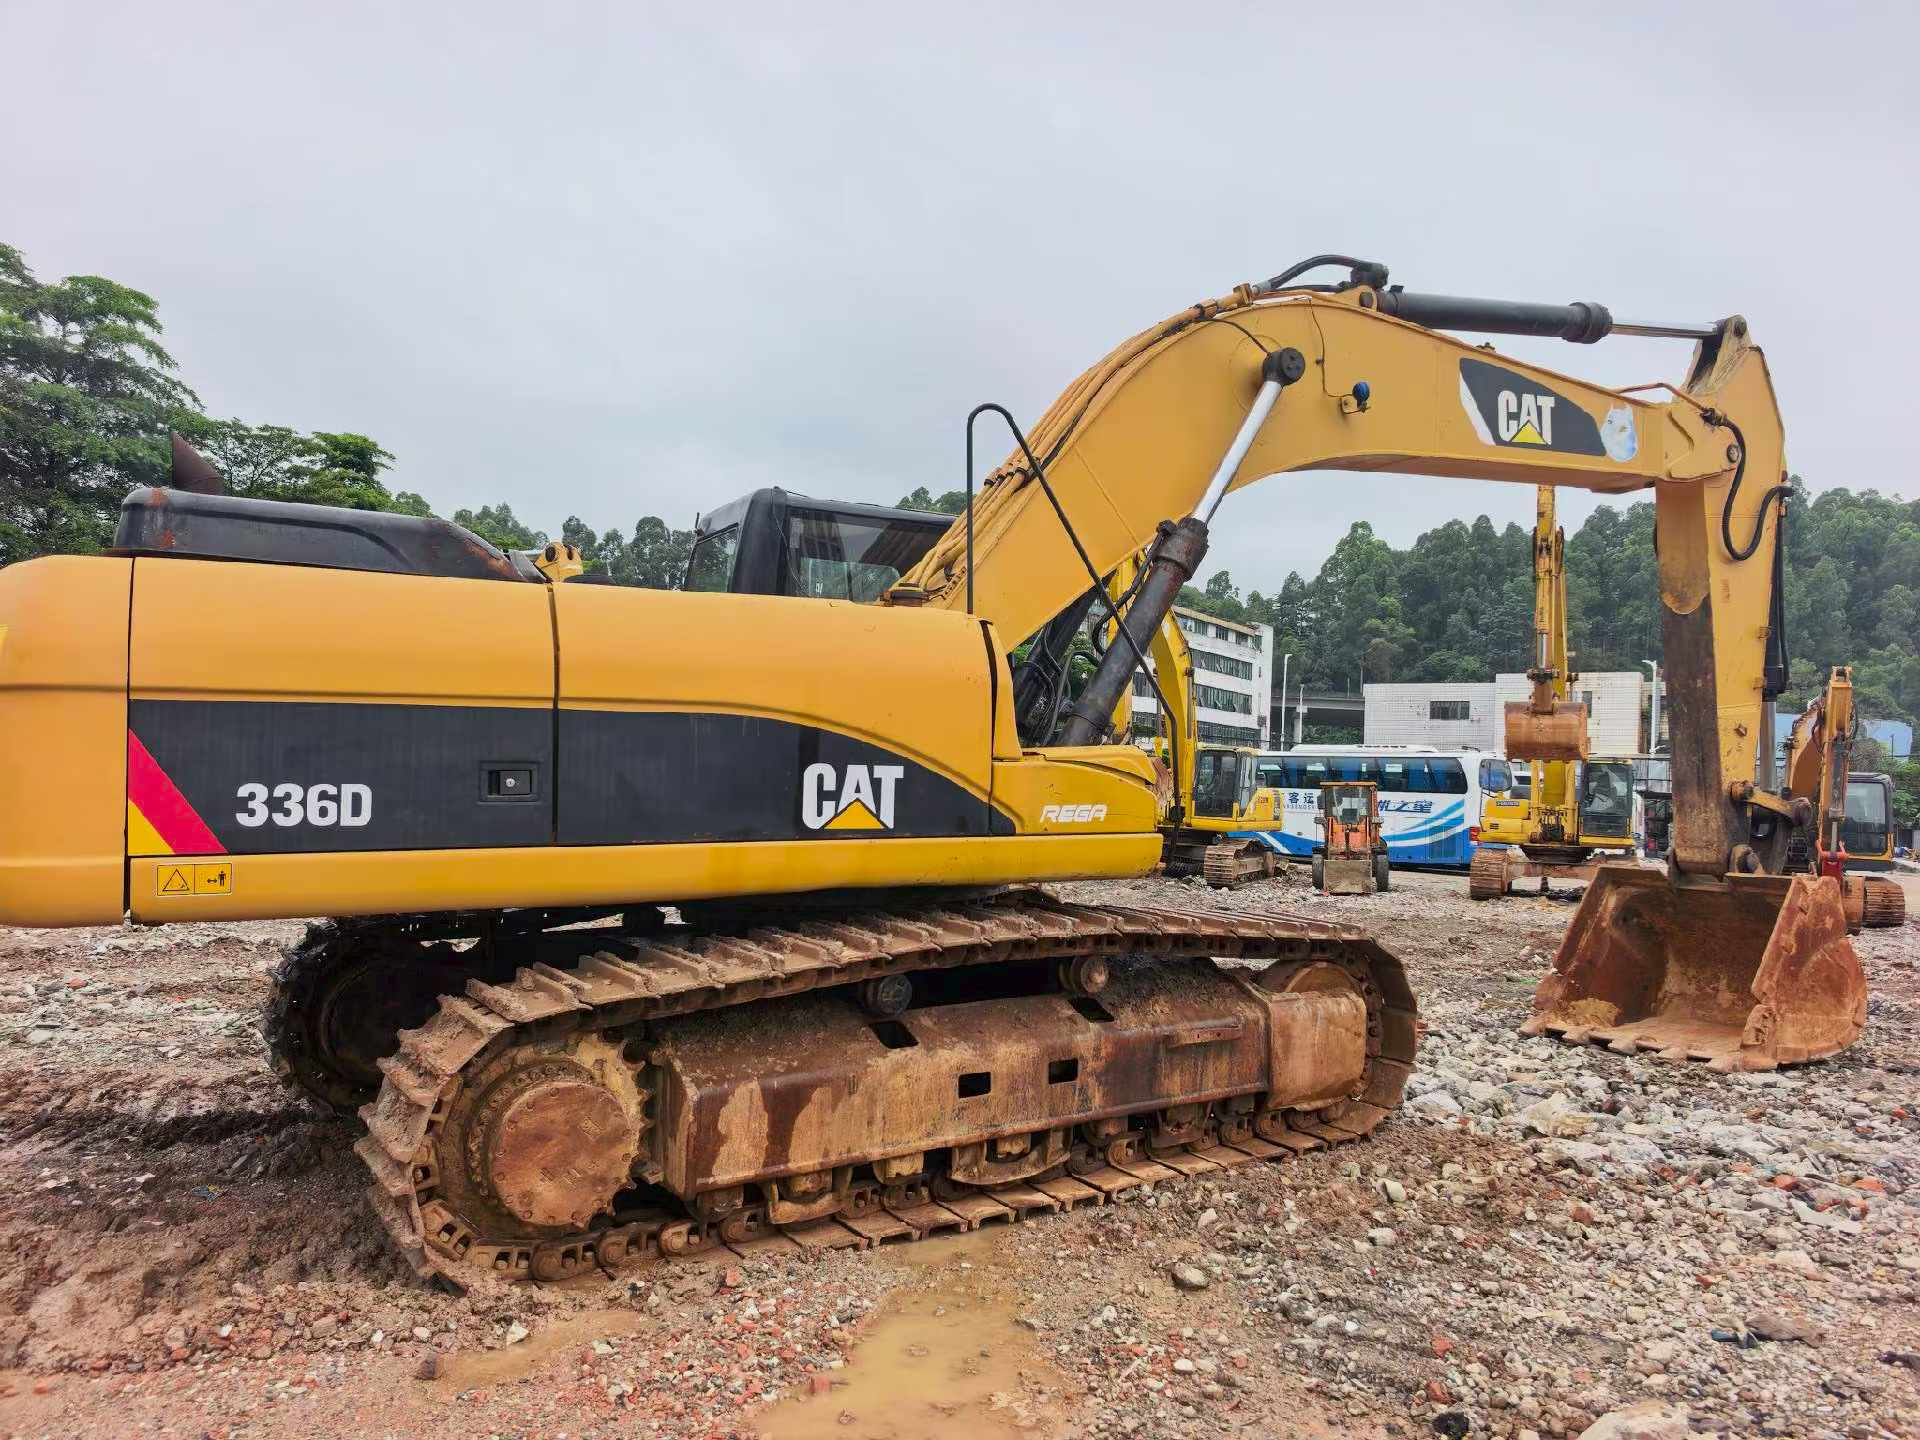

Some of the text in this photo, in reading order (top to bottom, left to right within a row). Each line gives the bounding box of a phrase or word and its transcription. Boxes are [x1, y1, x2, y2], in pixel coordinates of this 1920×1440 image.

[1498, 390, 1555, 446] CAT
[235, 782, 373, 827] 336D
[802, 762, 905, 830] CAT
[1288, 791, 1315, 804] 客运
